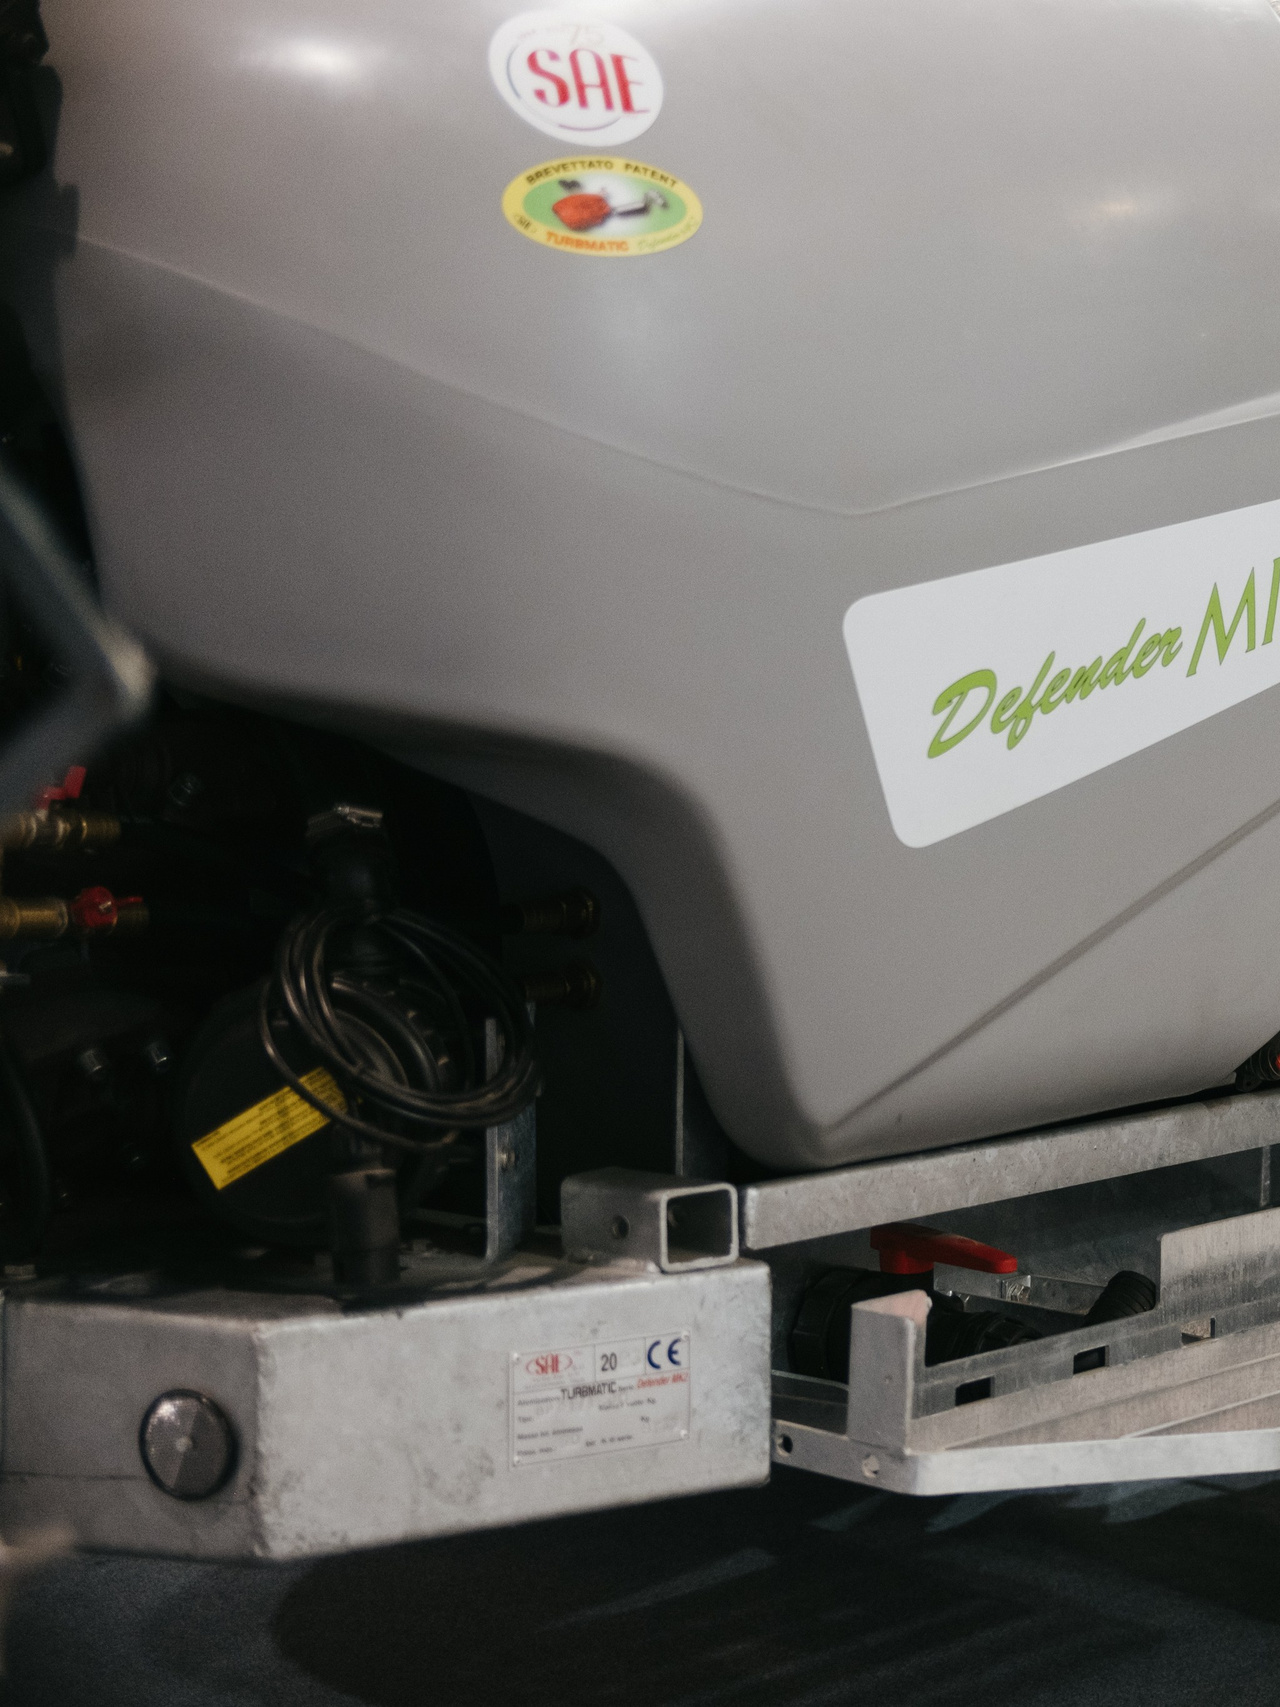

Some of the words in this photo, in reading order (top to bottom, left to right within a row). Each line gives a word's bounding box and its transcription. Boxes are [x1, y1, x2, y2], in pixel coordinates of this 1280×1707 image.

[527, 48, 650, 114] SAE
[525, 159, 615, 186] BREVETTATO
[624, 162, 678, 189] PATENT
[545, 231, 630, 253] TURBMATIC
[926, 617, 1185, 760] Defender
[601, 1352, 618, 1373] 20
[647, 1337, 682, 1370] CE
[561, 1381, 618, 1400] TURBMATIC
